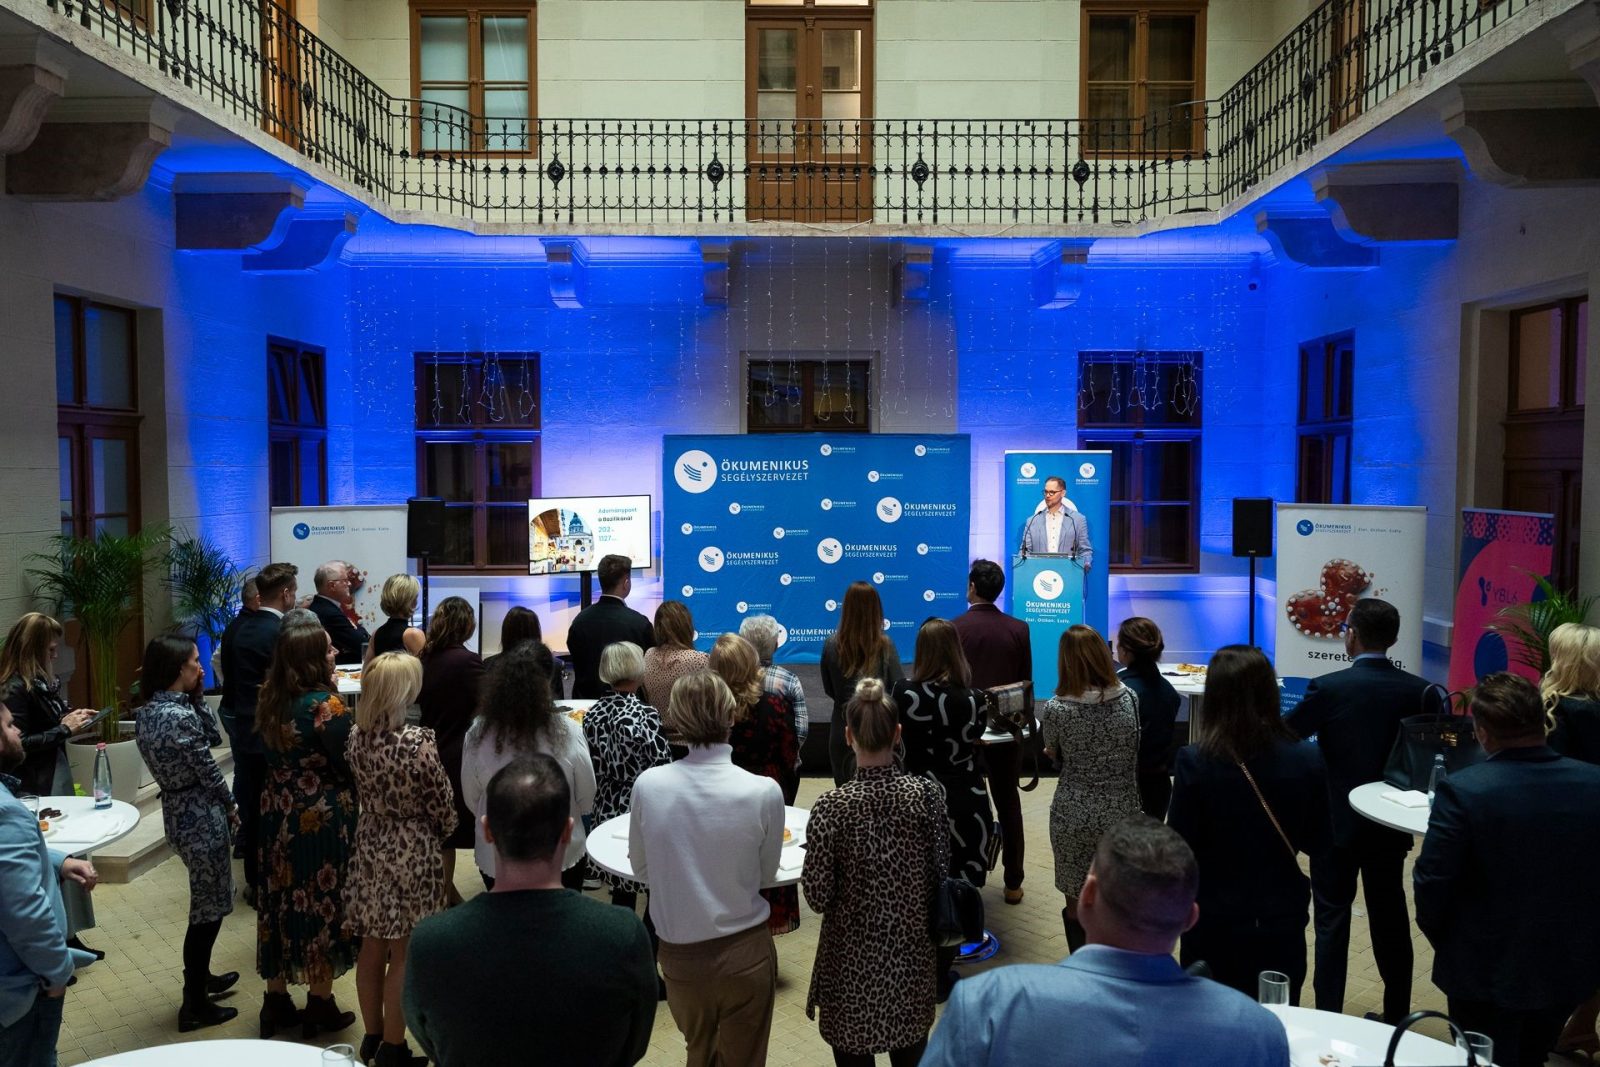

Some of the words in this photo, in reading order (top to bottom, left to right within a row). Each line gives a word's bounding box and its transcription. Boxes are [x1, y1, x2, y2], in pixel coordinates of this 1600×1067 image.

[721, 459, 809, 471] ÖKUMENIKUS
[721, 472, 809, 482] SEGÉLYSZERVEZET
[904, 502, 956, 510] ÖKUMENIKUS
[844, 543, 897, 552] ÖKUMENIKUS
[726, 551, 779, 559] ÖKUMENIKUS
[726, 558, 779, 566] SEGÉLYSZERVEZET
[1025, 600, 1071, 608] ÖKUMENIKUS
[790, 628, 837, 636] ÖKUMENIK
